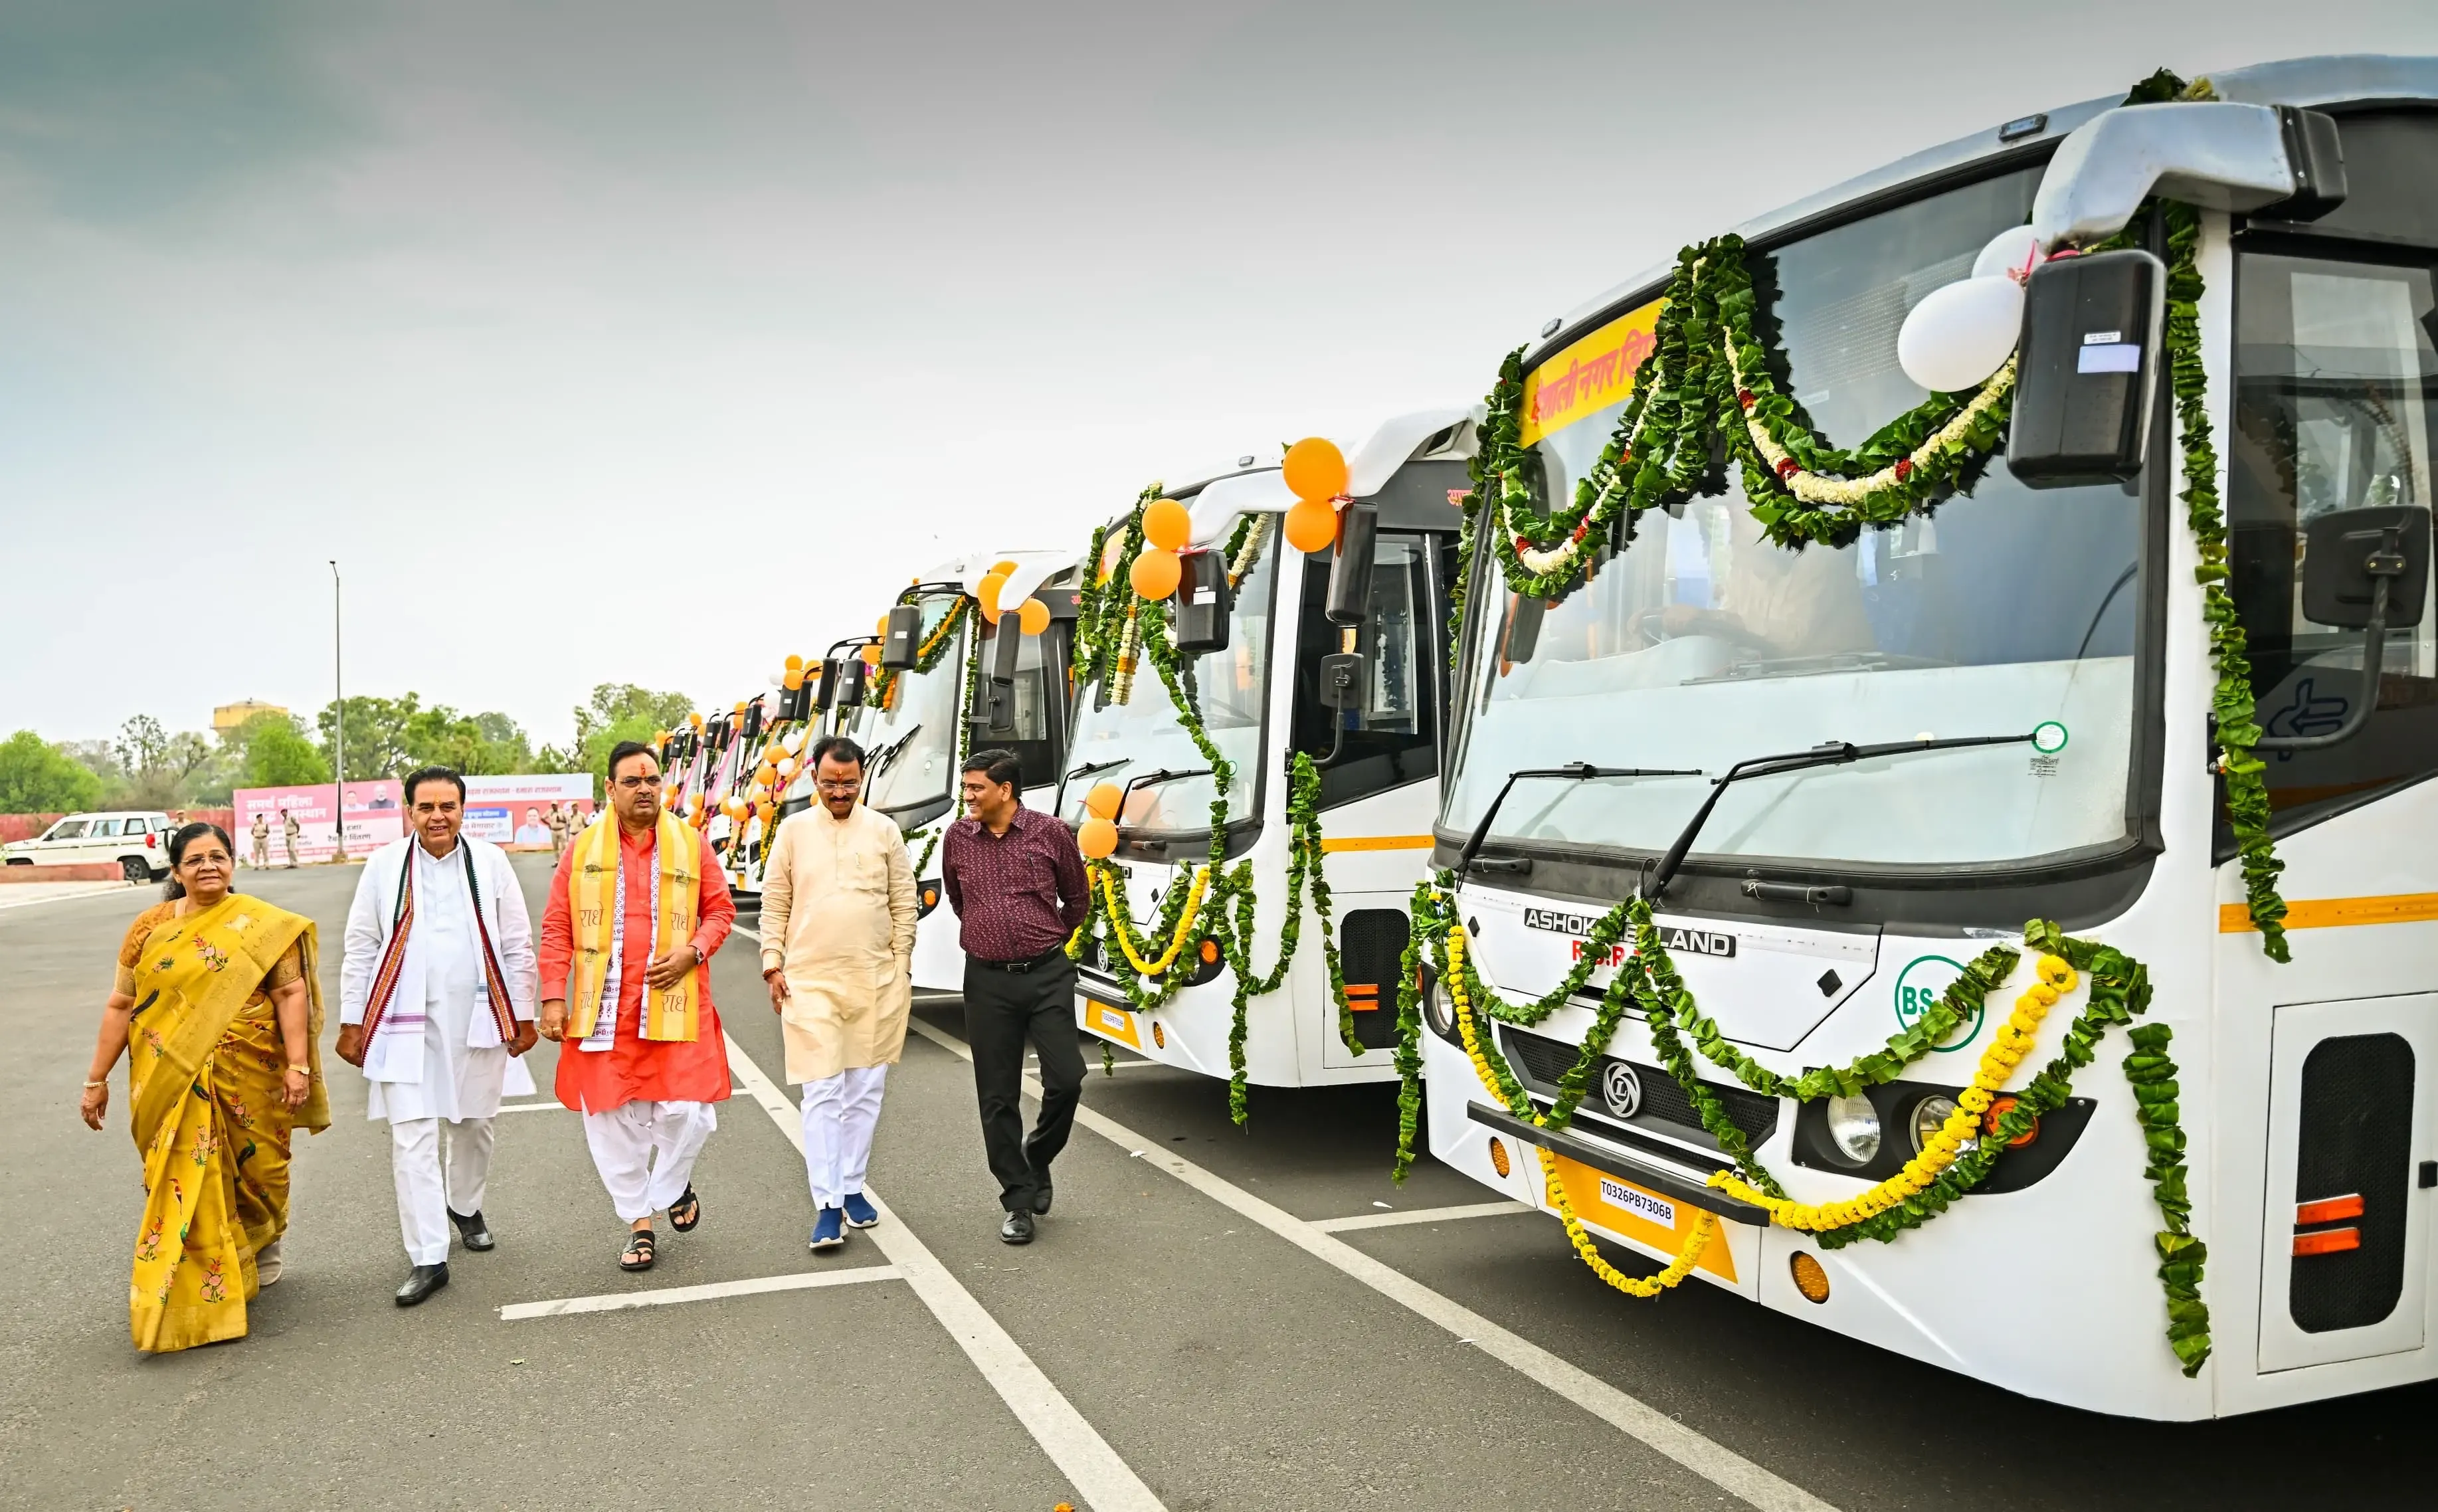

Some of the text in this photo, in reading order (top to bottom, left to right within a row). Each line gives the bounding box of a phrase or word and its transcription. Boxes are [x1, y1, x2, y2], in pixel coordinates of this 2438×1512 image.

[1578, 347, 1620, 401] नगर
[579, 901, 606, 927] राधे
[670, 907, 690, 931] राधे
[660, 988, 690, 1013] राधे
[1601, 1181, 1672, 1220] T0326PB7306B
